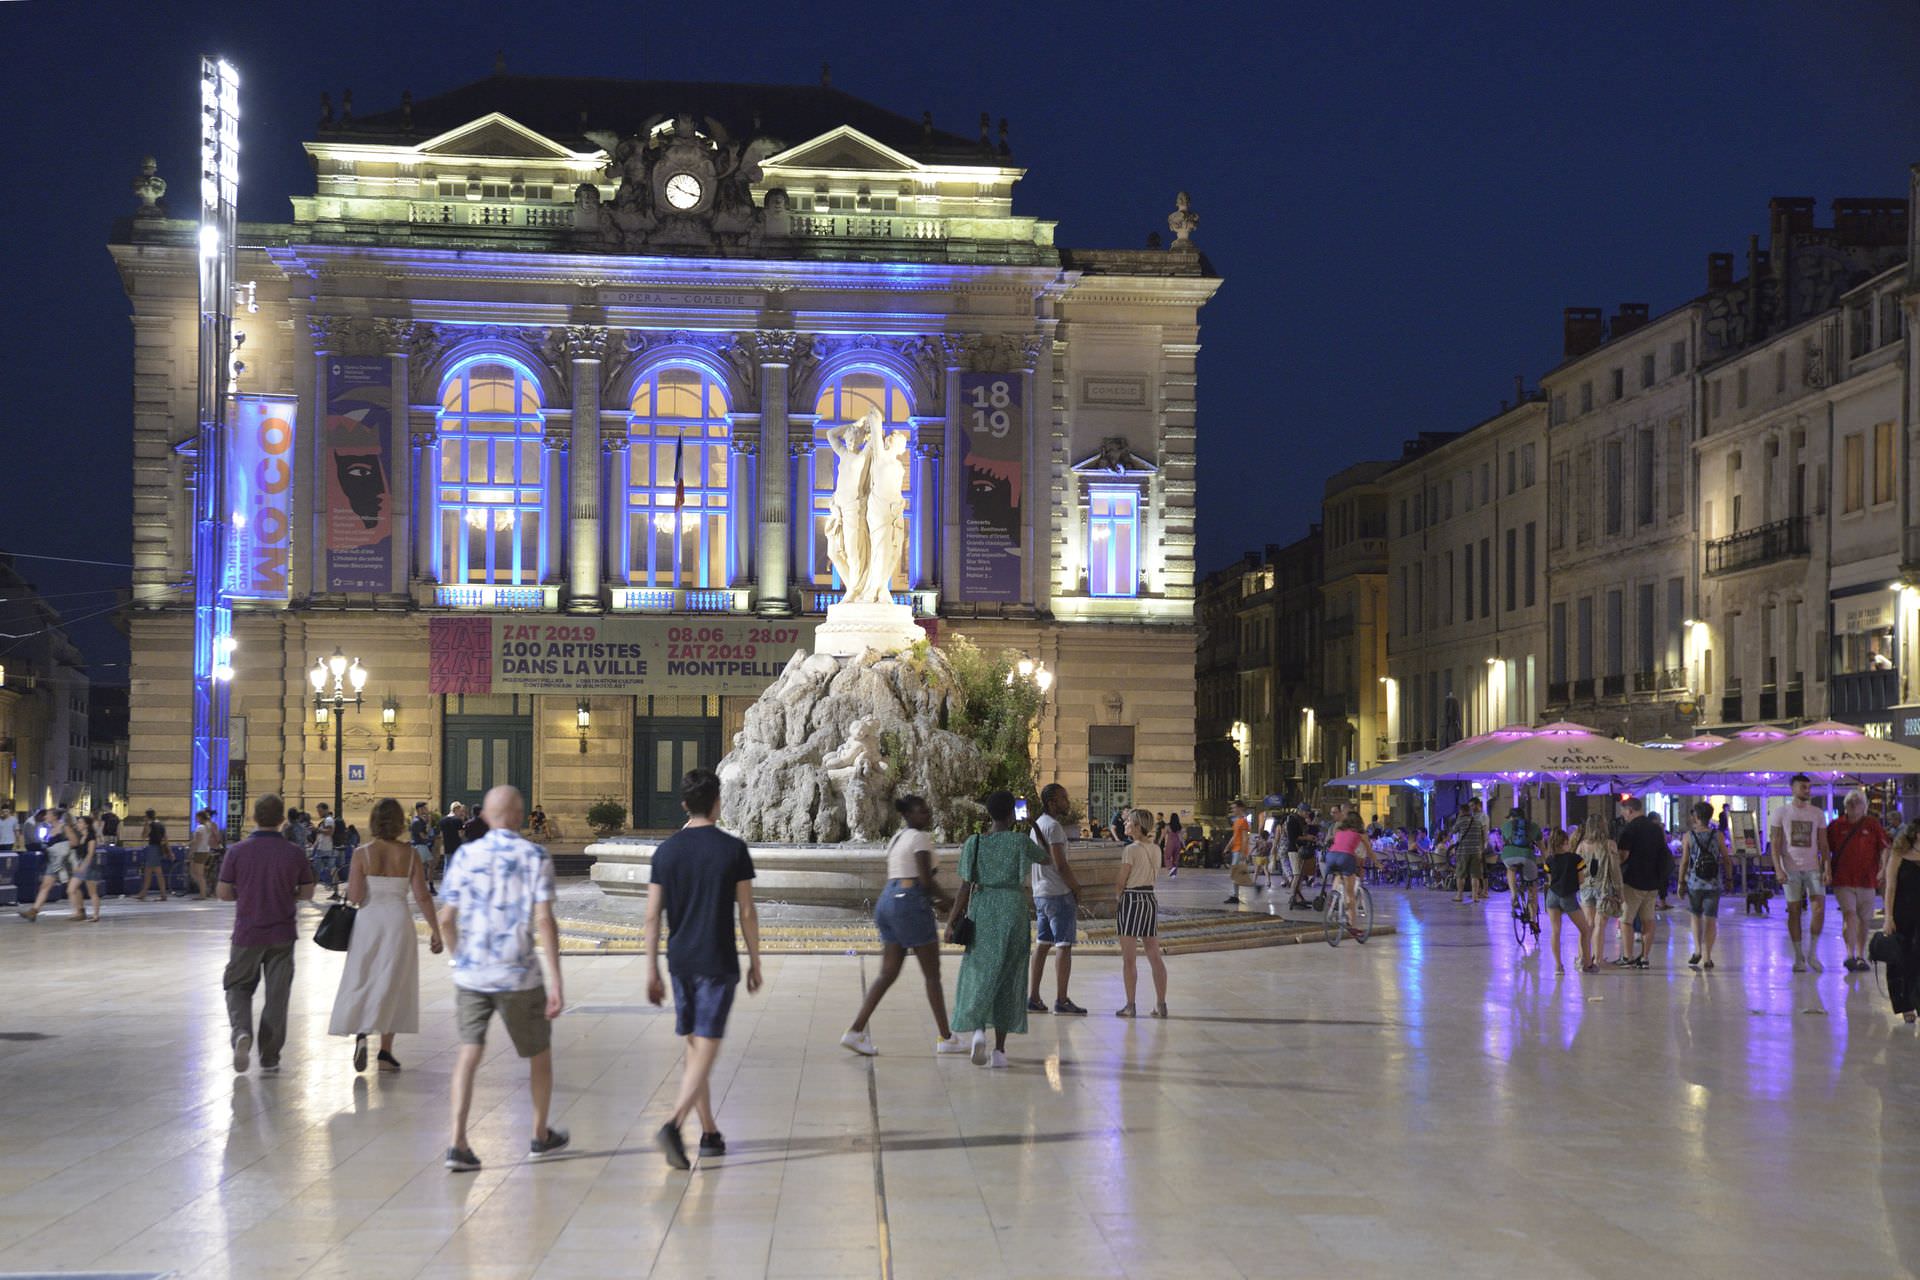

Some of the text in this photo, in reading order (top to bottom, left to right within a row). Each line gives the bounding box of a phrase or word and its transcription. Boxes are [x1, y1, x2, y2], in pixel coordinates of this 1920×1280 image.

[618, 293, 745, 305] OPERA COMEDIE
[972, 381, 1010, 408] 18
[1091, 386, 1137, 396] COMEDIE
[972, 410, 1010, 438] 19
[431, 626, 491, 650] ZAT
[503, 625, 596, 641] ZAT 2019
[667, 627, 799, 644] 08.06 28.07
[502, 642, 641, 659] 100 ARTISTES
[667, 644, 757, 660] ZAT 2019
[431, 651, 491, 675] ZAT
[502, 659, 648, 676] DANS LA VILLE
[1546, 755, 1614, 764] YAM'S
[1823, 752, 1897, 762] YAM'S
[351, 769, 363, 779] M
